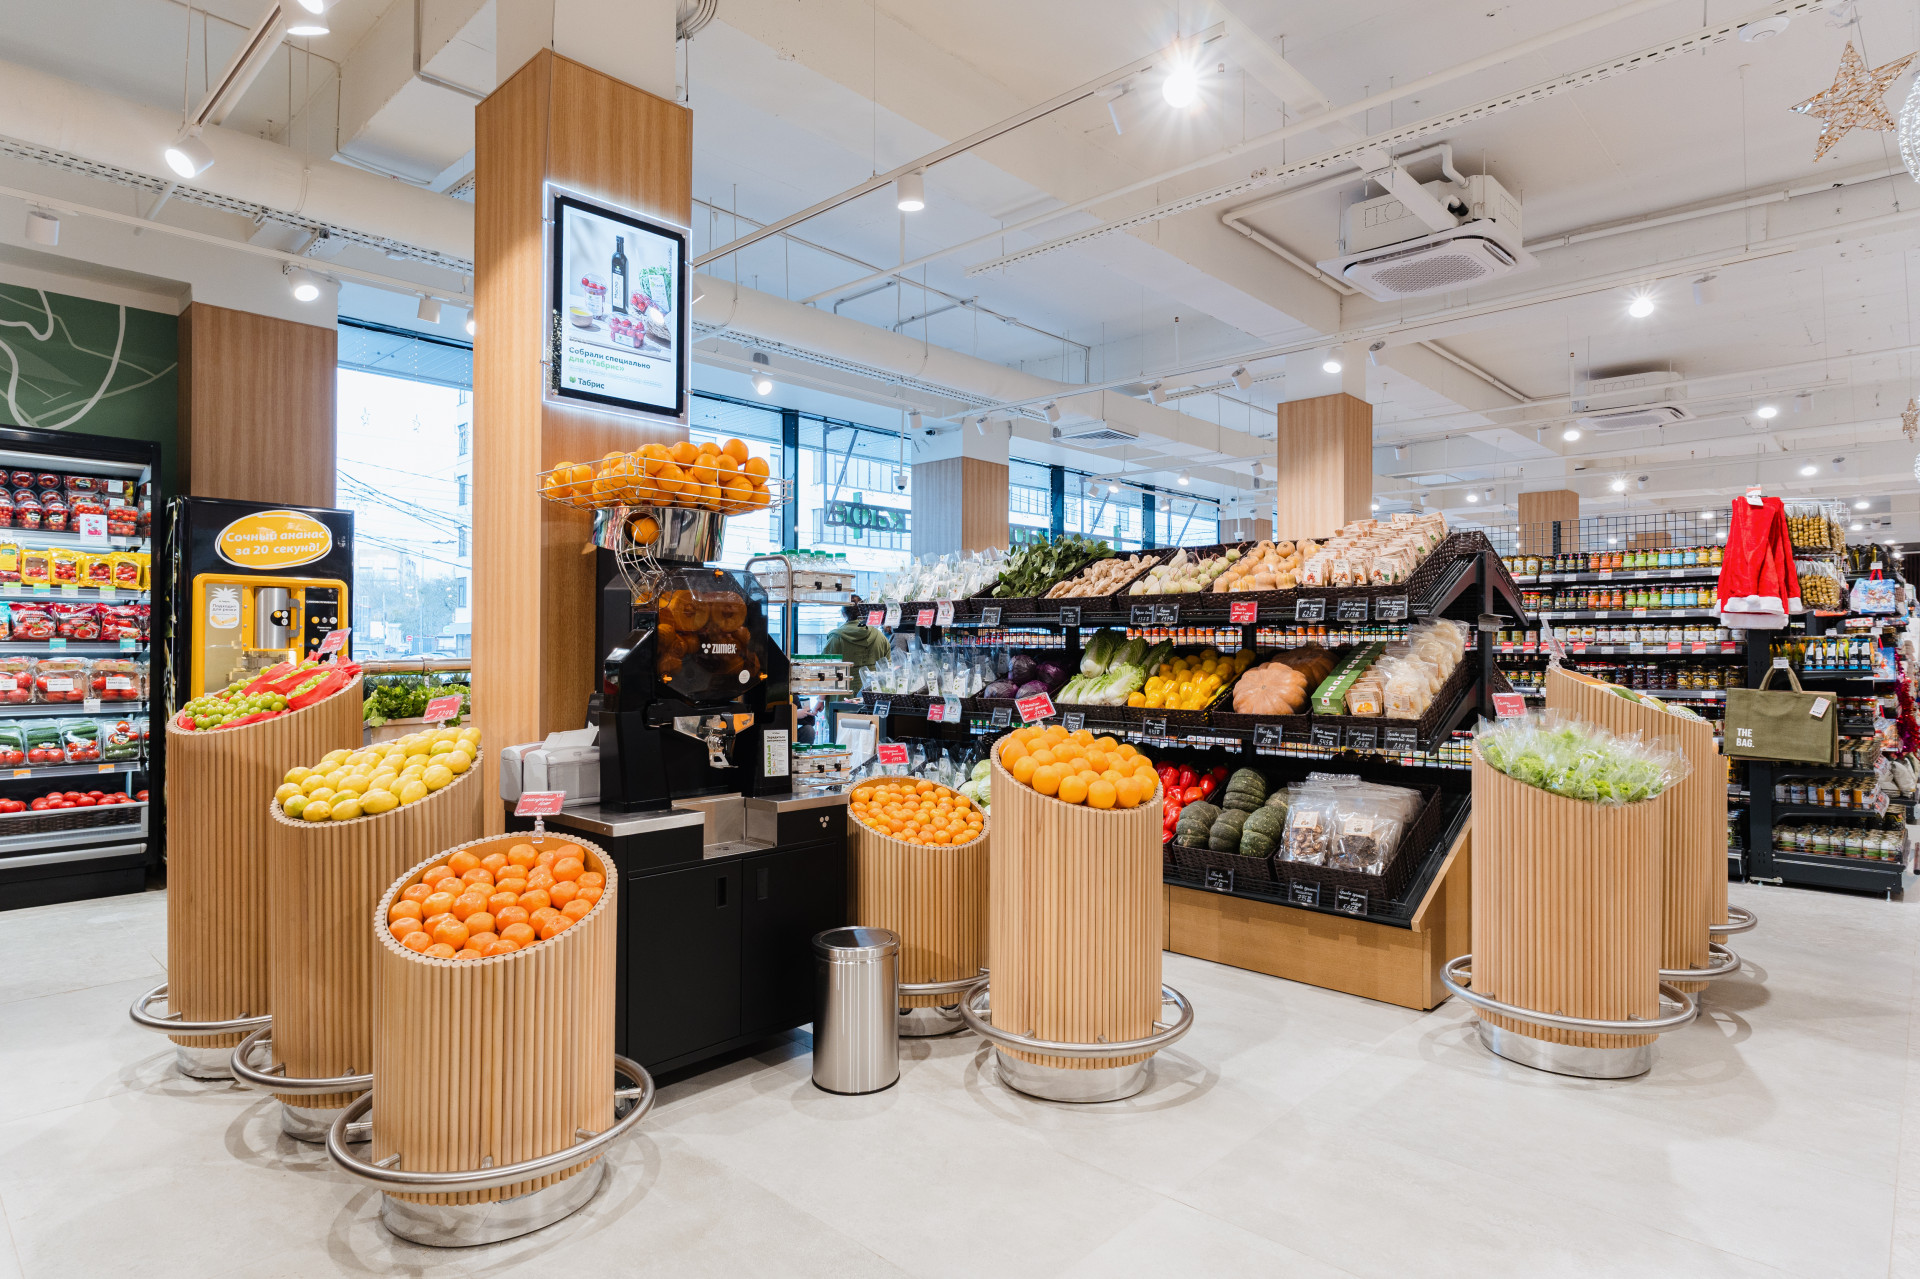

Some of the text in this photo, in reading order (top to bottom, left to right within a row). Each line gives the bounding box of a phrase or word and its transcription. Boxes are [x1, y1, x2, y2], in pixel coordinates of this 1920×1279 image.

[568, 356, 625, 372] для «Табрис»
[569, 346, 651, 370] Собрали специально
[578, 377, 605, 390] Табрис
[225, 530, 325, 543] Сочный ананас
[234, 542, 320, 556] за 20 секунд!
[712, 643, 737, 654] zumex
[1736, 727, 1753, 738] THE
[1736, 737, 1755, 748] BAG.
